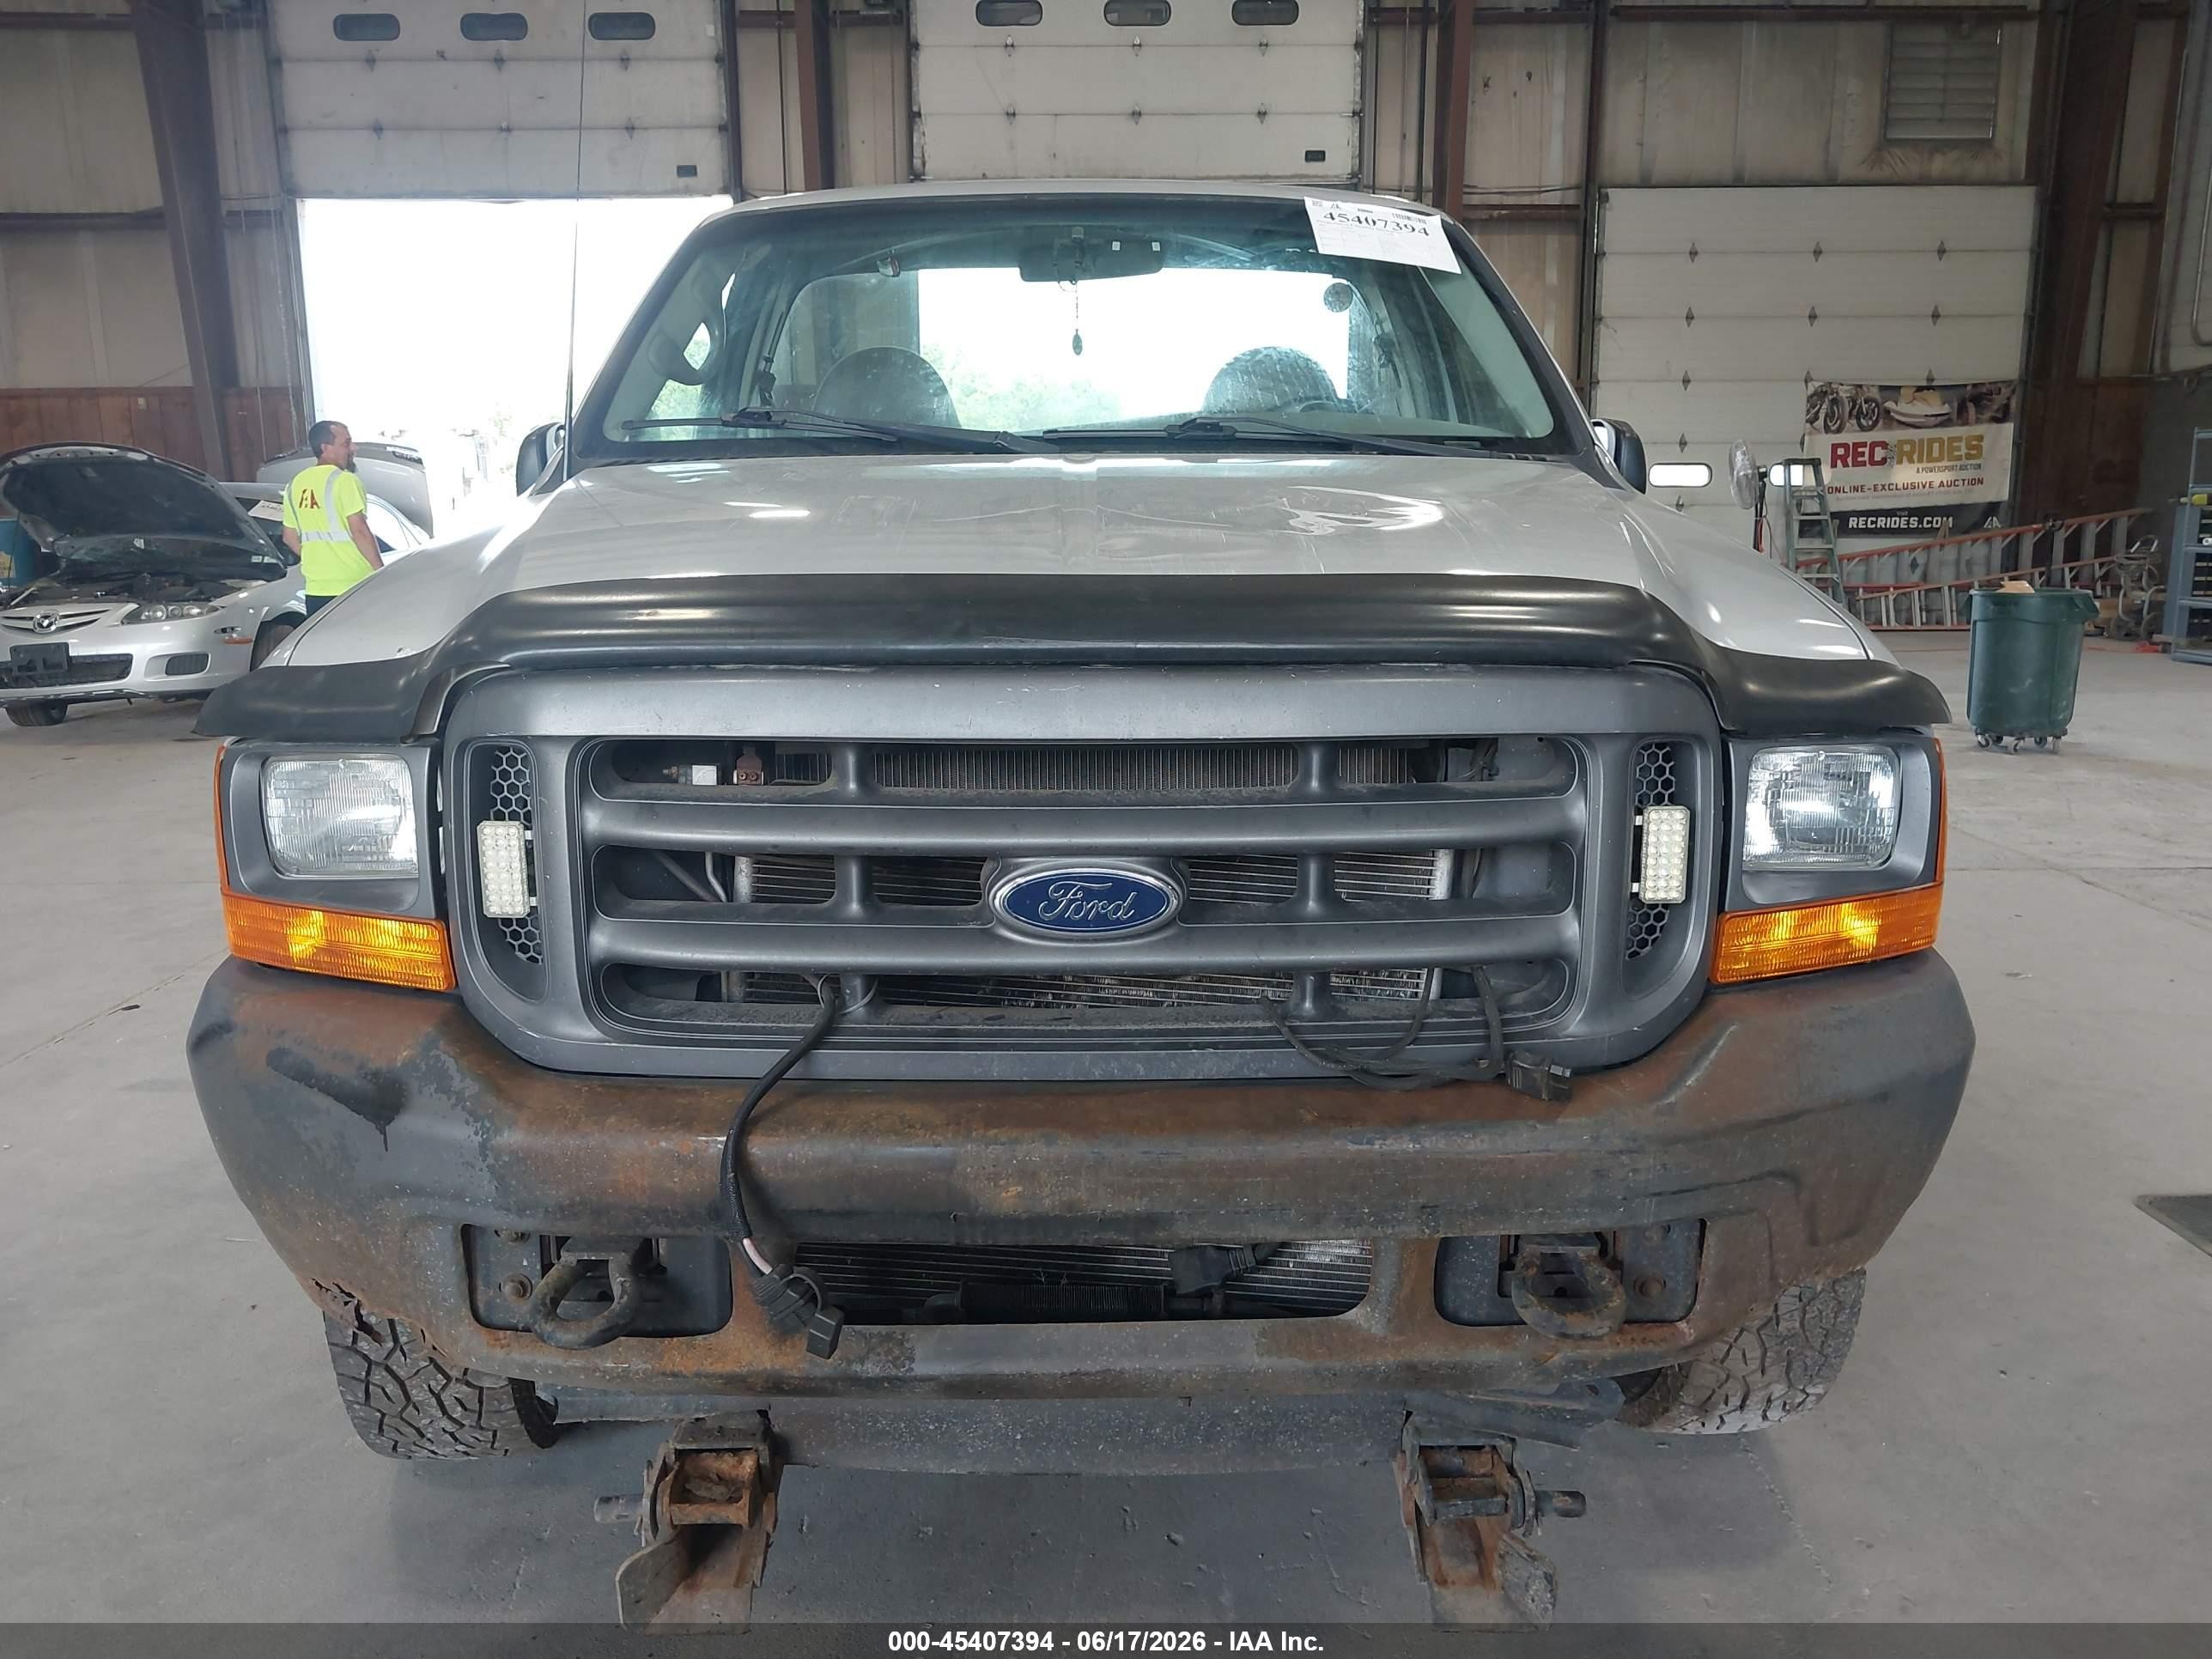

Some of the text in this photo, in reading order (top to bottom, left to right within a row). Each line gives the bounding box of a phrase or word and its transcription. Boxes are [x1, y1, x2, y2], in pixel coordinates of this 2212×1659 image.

[1323, 211, 1430, 237] 45407394
[1830, 434, 1984, 469] REC RIDES
[1827, 480, 1935, 495] ONLINE-EXCLUSIVE
[1938, 477, 1984, 489] AUCTION
[1848, 516, 1953, 529] RECRIDES.COM
[1038, 880, 1137, 921] Ford
